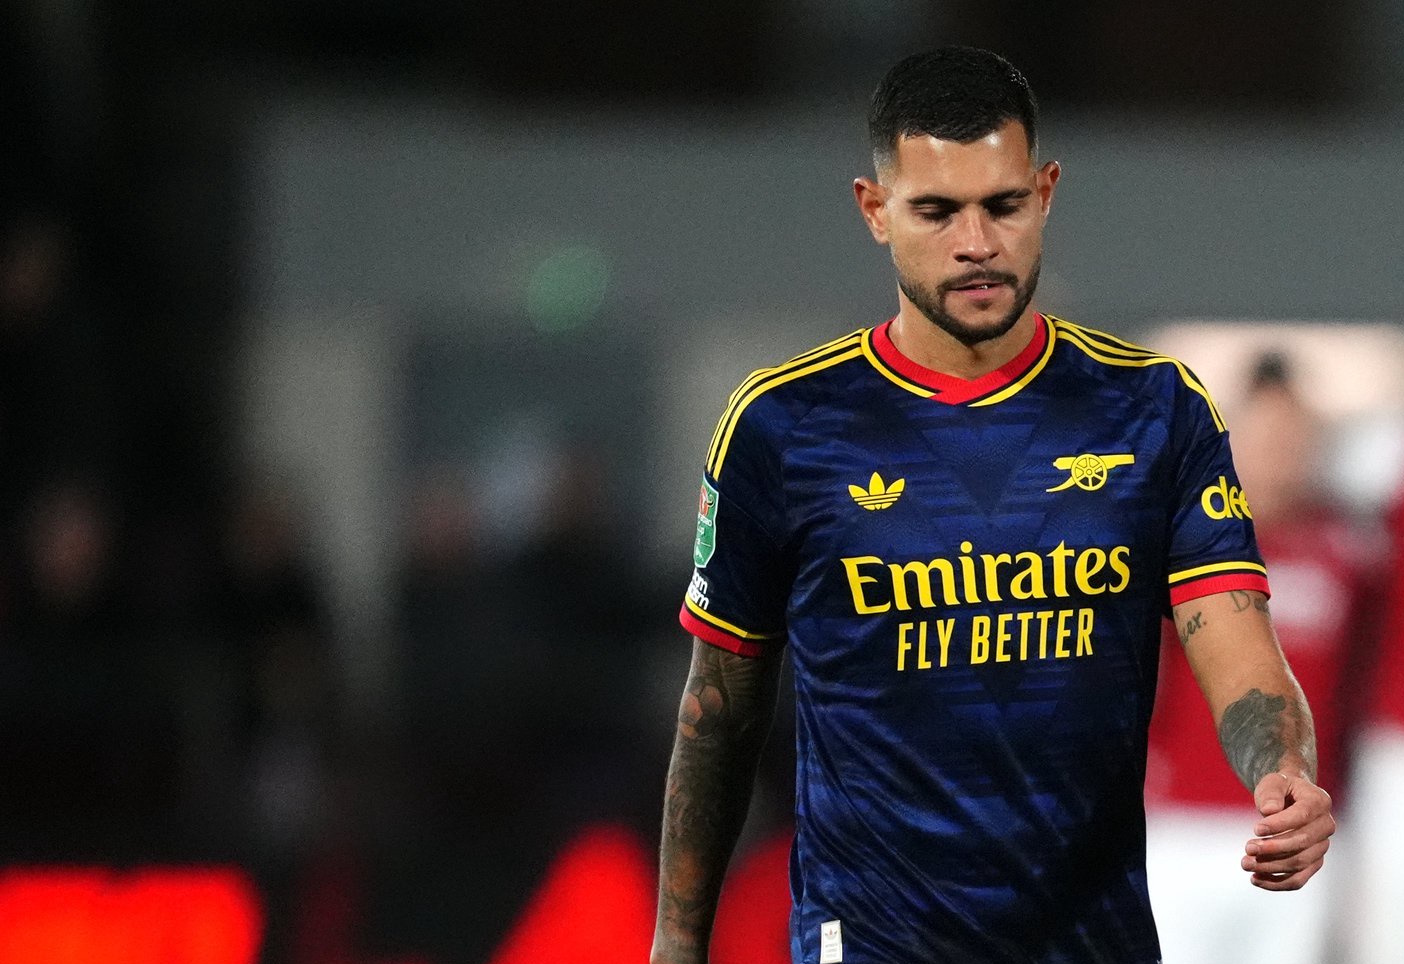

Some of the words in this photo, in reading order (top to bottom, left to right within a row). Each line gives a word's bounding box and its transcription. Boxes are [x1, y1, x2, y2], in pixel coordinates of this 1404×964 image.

[841, 540, 1131, 616] Emirates
[897, 615, 955, 671] FLY
[970, 607, 1094, 666] BETTER
